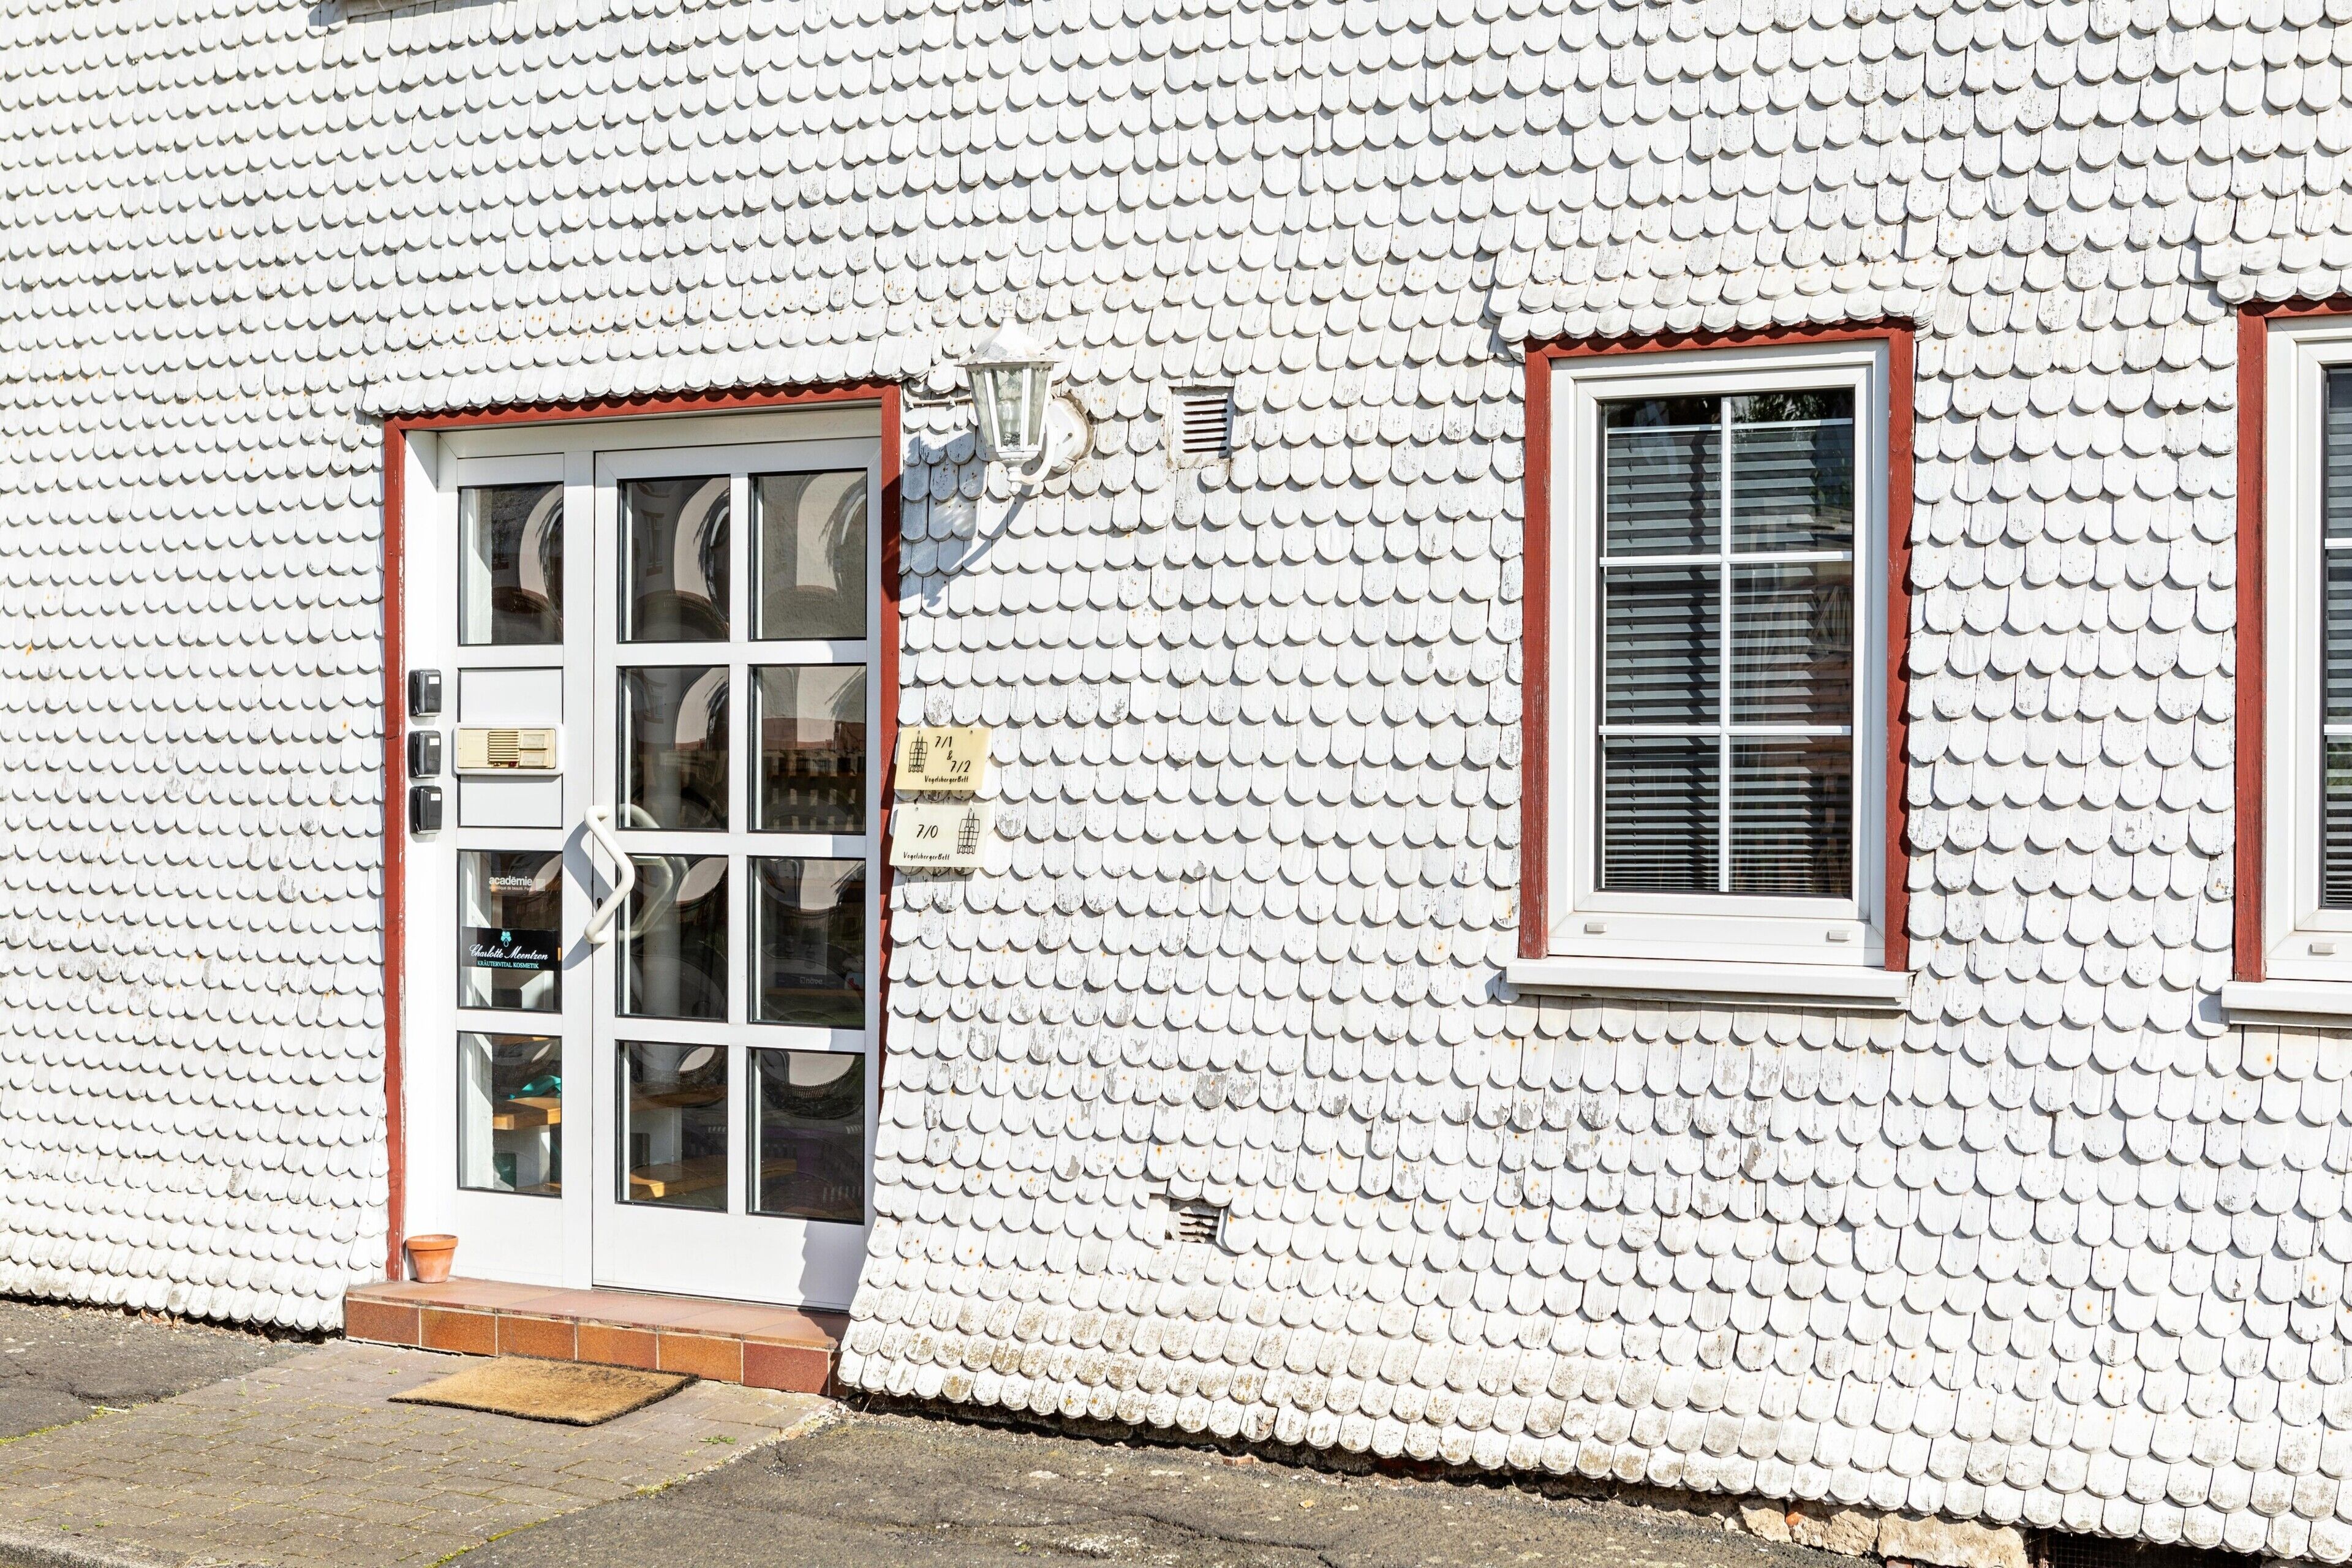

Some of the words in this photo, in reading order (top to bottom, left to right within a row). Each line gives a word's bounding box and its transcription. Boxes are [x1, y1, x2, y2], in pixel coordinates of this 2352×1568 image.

[935, 736, 952, 747] 7/1
[946, 751, 952, 761] &
[950, 760, 971, 772] 7/2
[916, 824, 938, 839] 7/0
[469, 944, 503, 958] Charlotte
[504, 946, 548, 960] Meentzen
